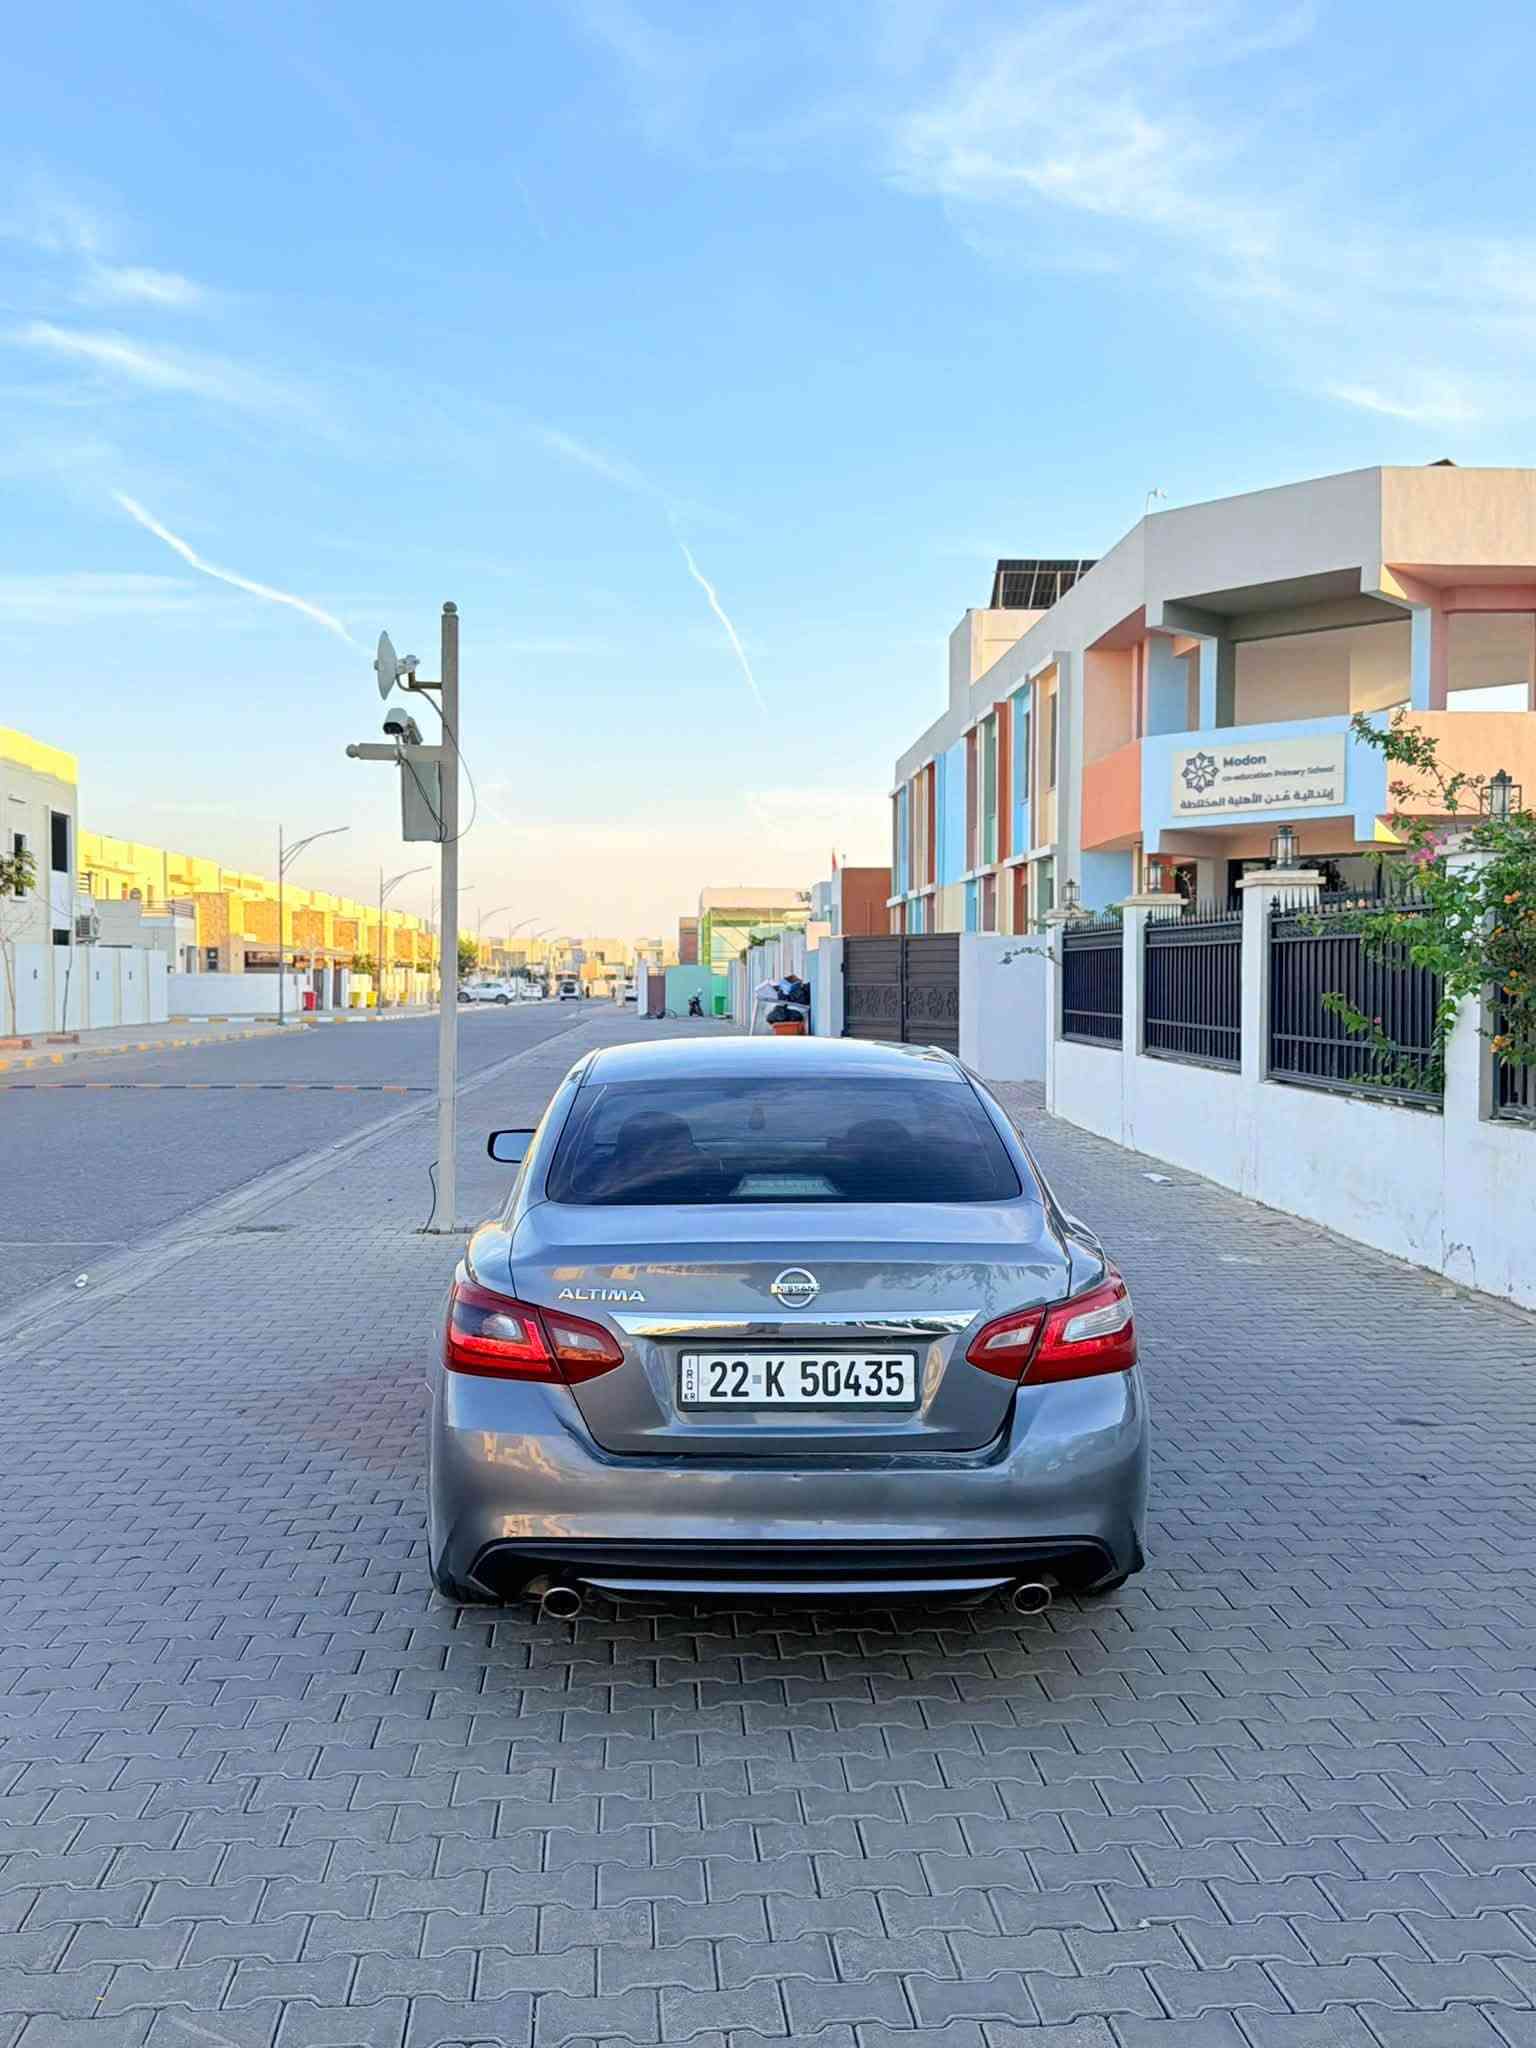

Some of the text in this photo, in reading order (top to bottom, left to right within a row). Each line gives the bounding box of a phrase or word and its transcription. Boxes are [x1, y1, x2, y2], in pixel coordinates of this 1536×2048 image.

[1223, 755, 1267, 768] Modon
[1274, 768, 1305, 777] Primary
[1307, 765, 1335, 774] School
[558, 1287, 647, 1302] ALTIMA
[709, 1360, 904, 1398] 22 K 50435
